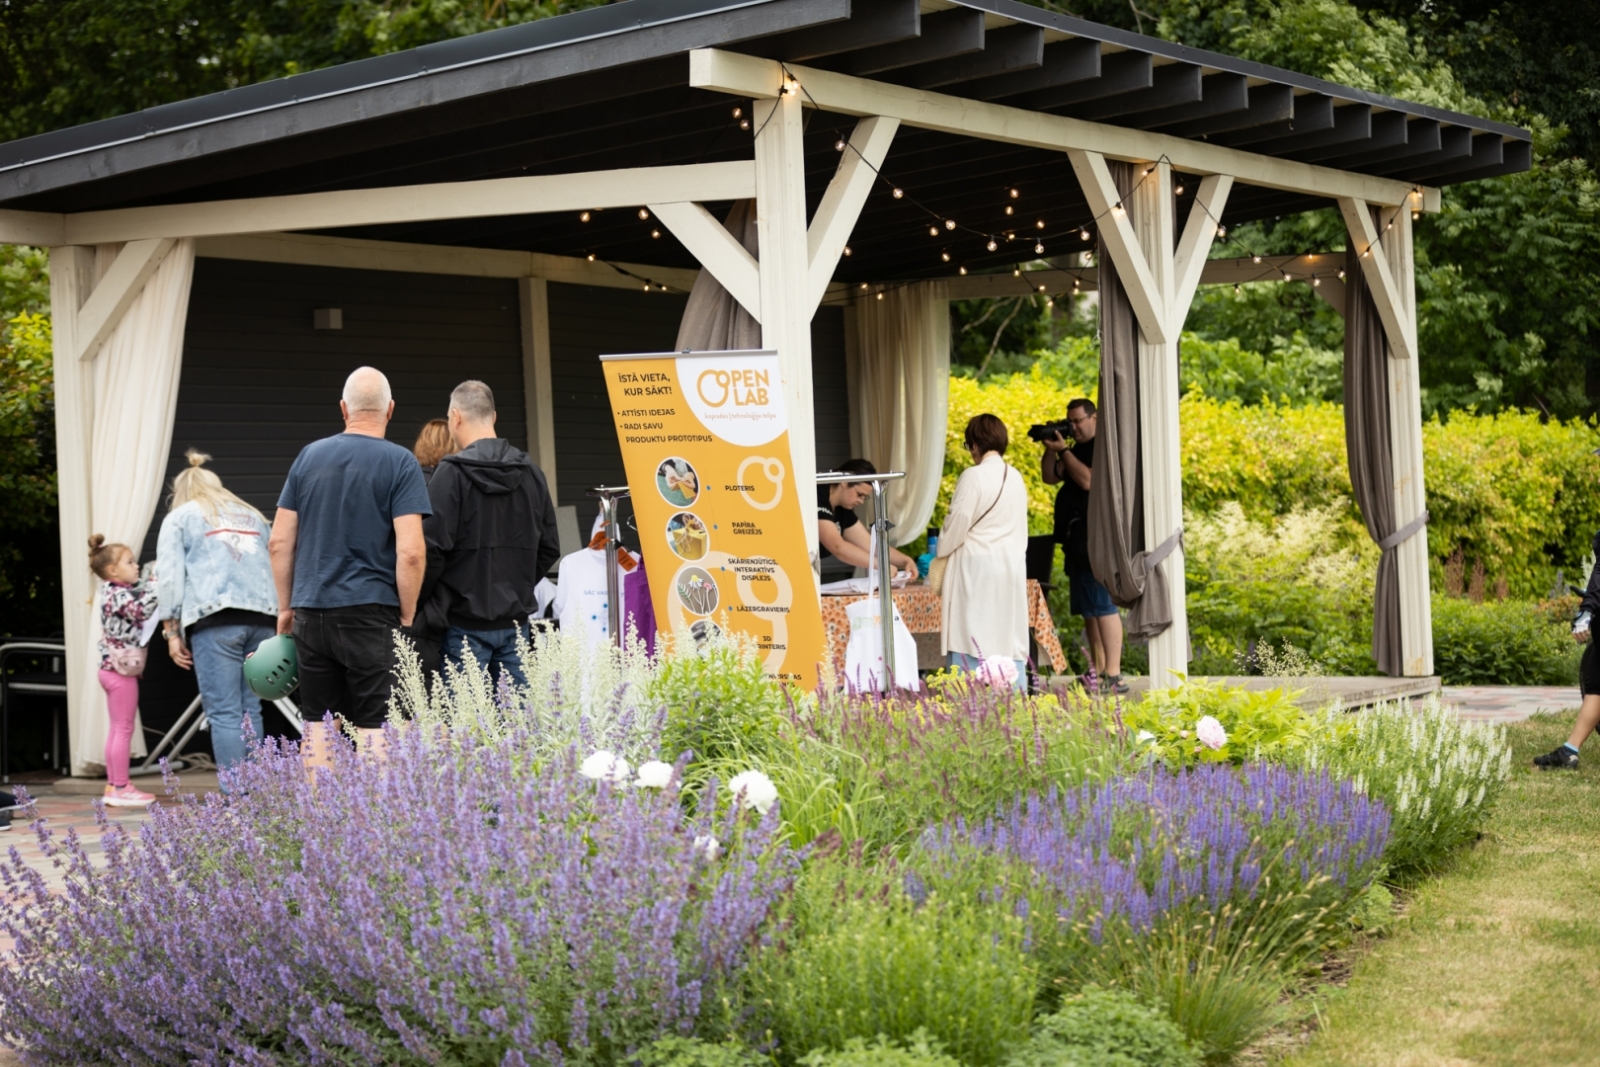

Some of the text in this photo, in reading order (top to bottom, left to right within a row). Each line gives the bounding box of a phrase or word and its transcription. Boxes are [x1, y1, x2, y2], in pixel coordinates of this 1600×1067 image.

[618, 372, 670, 382] ĪSTĀ VIETA,
[624, 385, 672, 396] KUR SĀKT!
[733, 388, 769, 406] LAB
[621, 409, 647, 417] ATTĪSTI
